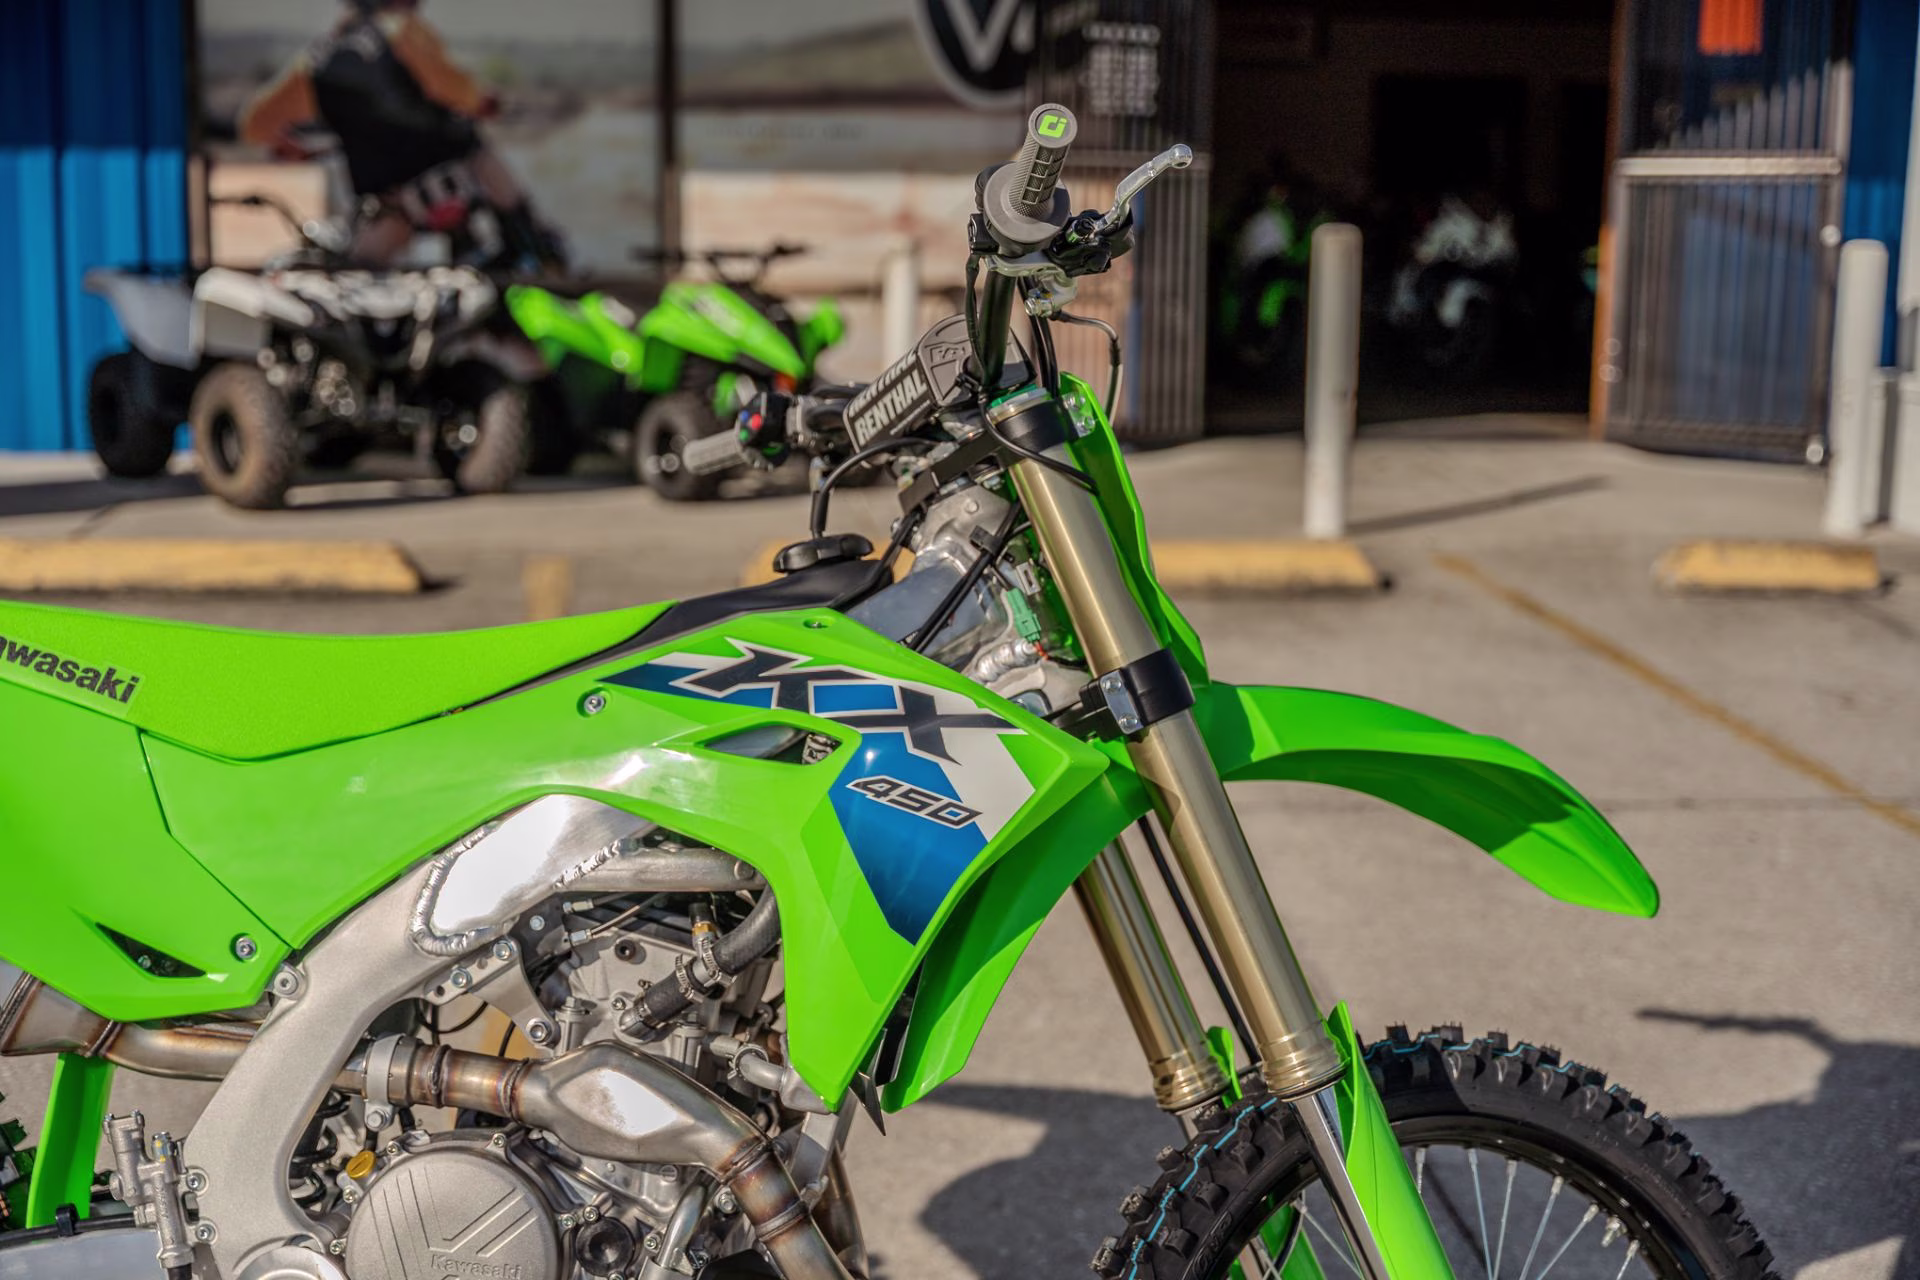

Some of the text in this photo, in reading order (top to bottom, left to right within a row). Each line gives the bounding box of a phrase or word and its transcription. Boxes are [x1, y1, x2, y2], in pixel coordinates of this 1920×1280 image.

[854, 369, 928, 446] RENTHAL
[850, 777, 984, 828] 450
[431, 1253, 522, 1280] Kawasaki
